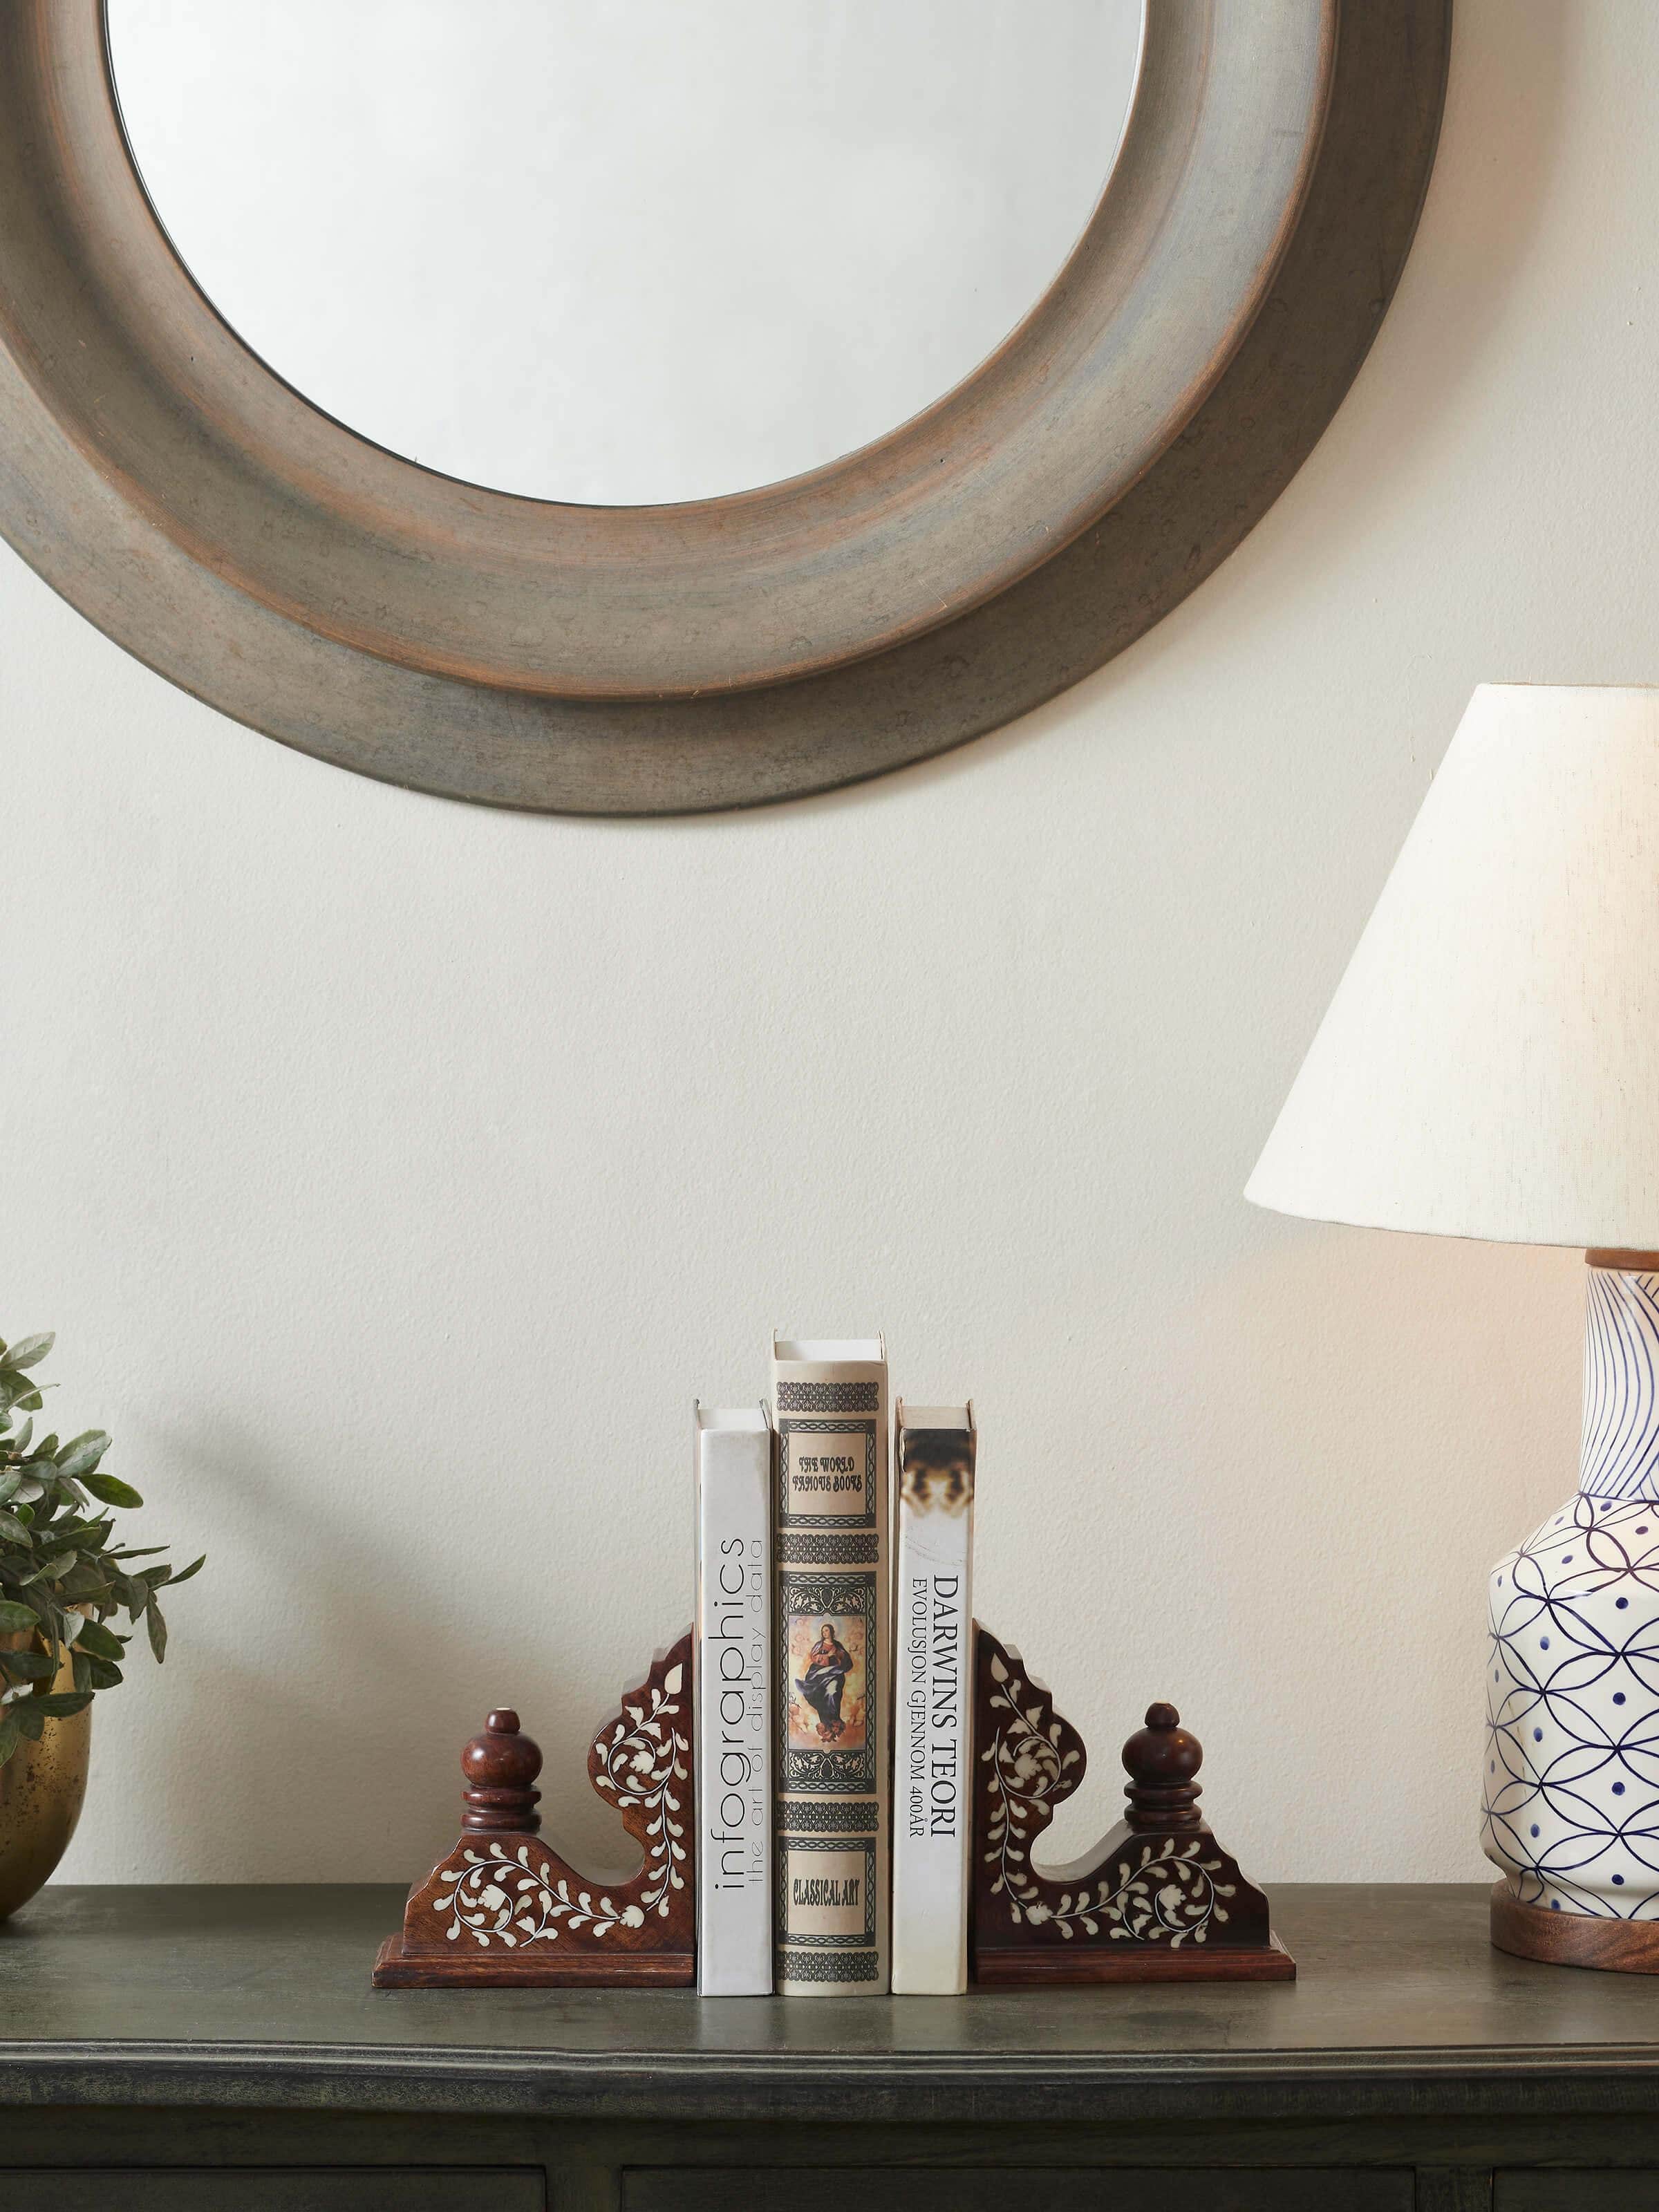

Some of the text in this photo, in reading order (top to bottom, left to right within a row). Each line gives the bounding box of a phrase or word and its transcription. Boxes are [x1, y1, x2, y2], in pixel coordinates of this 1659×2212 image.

[798, 1456, 854, 1474] THE WORLD
[746, 1540, 763, 1613] data
[907, 1577, 928, 1684] EVOLUSJON
[708, 1539, 751, 1890] infographics
[746, 1628, 767, 1732] display
[930, 1574, 959, 1838] DARWINS TEORI
[747, 1745, 763, 1772] of
[906, 1690, 926, 1781] GJENNOM
[747, 1785, 763, 1826] art
[793, 1878, 860, 1906] CLASSICAL ART
